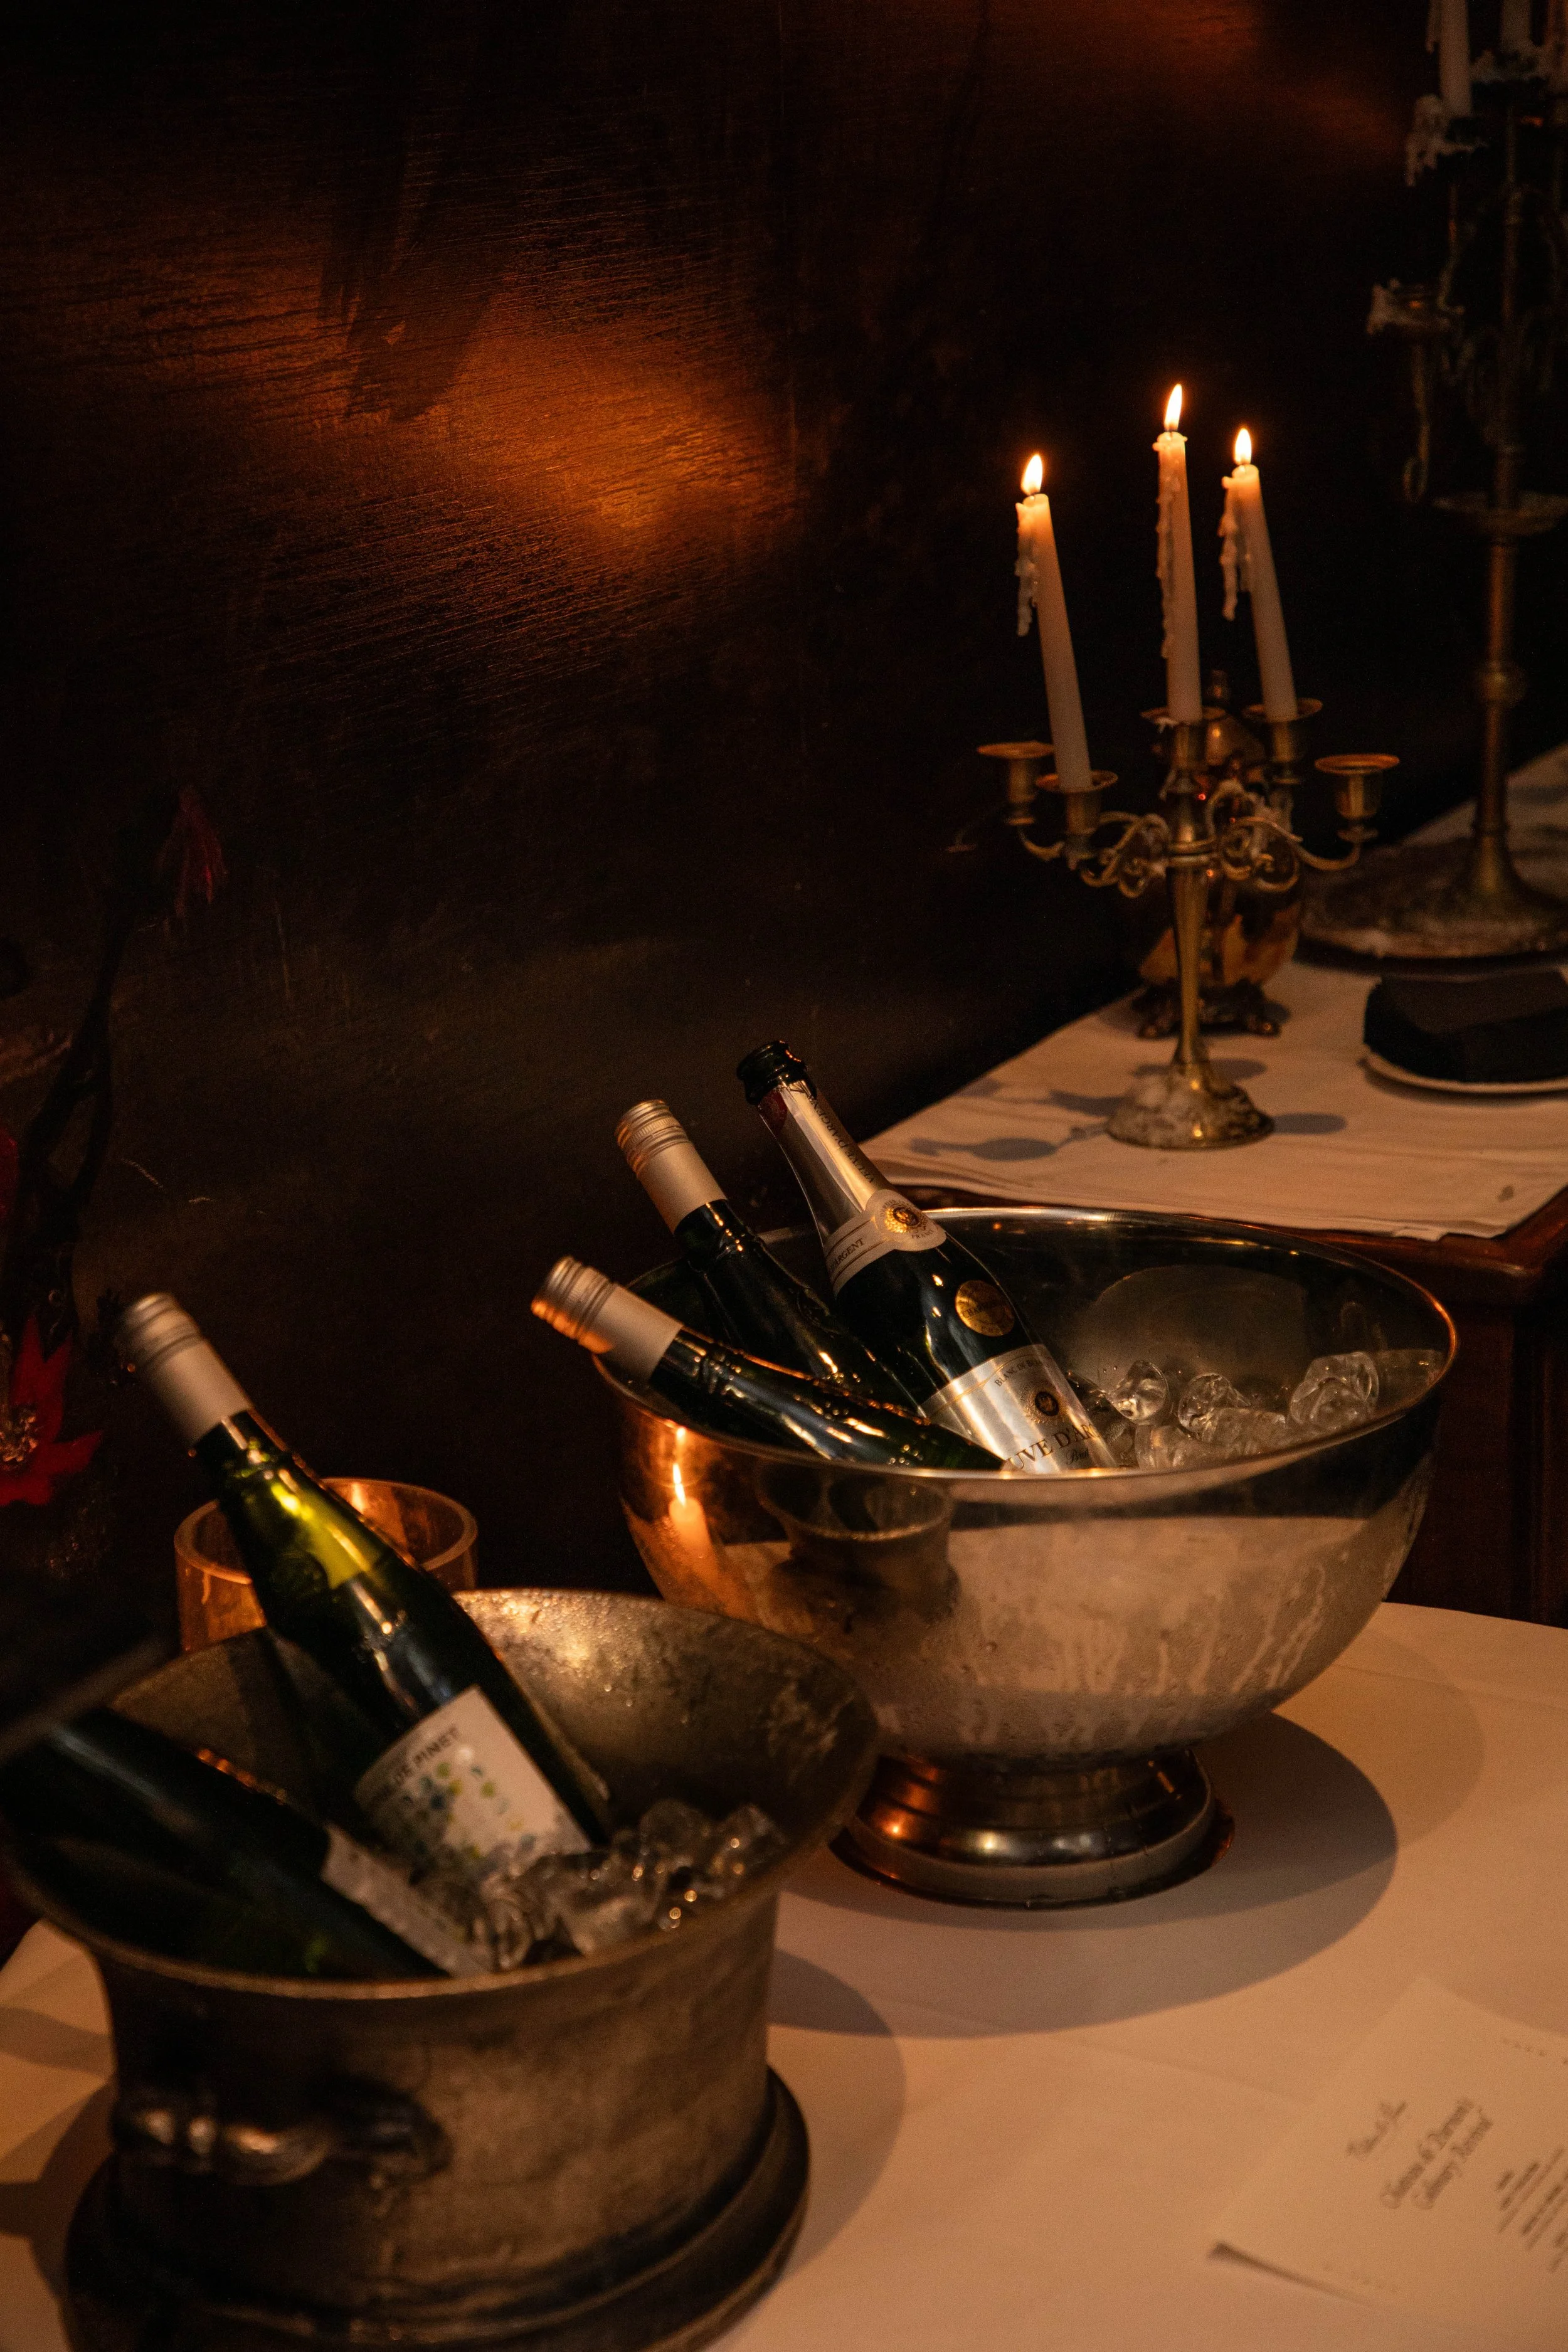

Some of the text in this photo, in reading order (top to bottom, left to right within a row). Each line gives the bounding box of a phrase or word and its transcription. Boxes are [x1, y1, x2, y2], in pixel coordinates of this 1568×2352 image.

[808, 1098, 847, 1149] D'ARGEN
[1007, 1437, 1054, 1468] UVE
[1065, 1448, 1089, 1466] Brut
